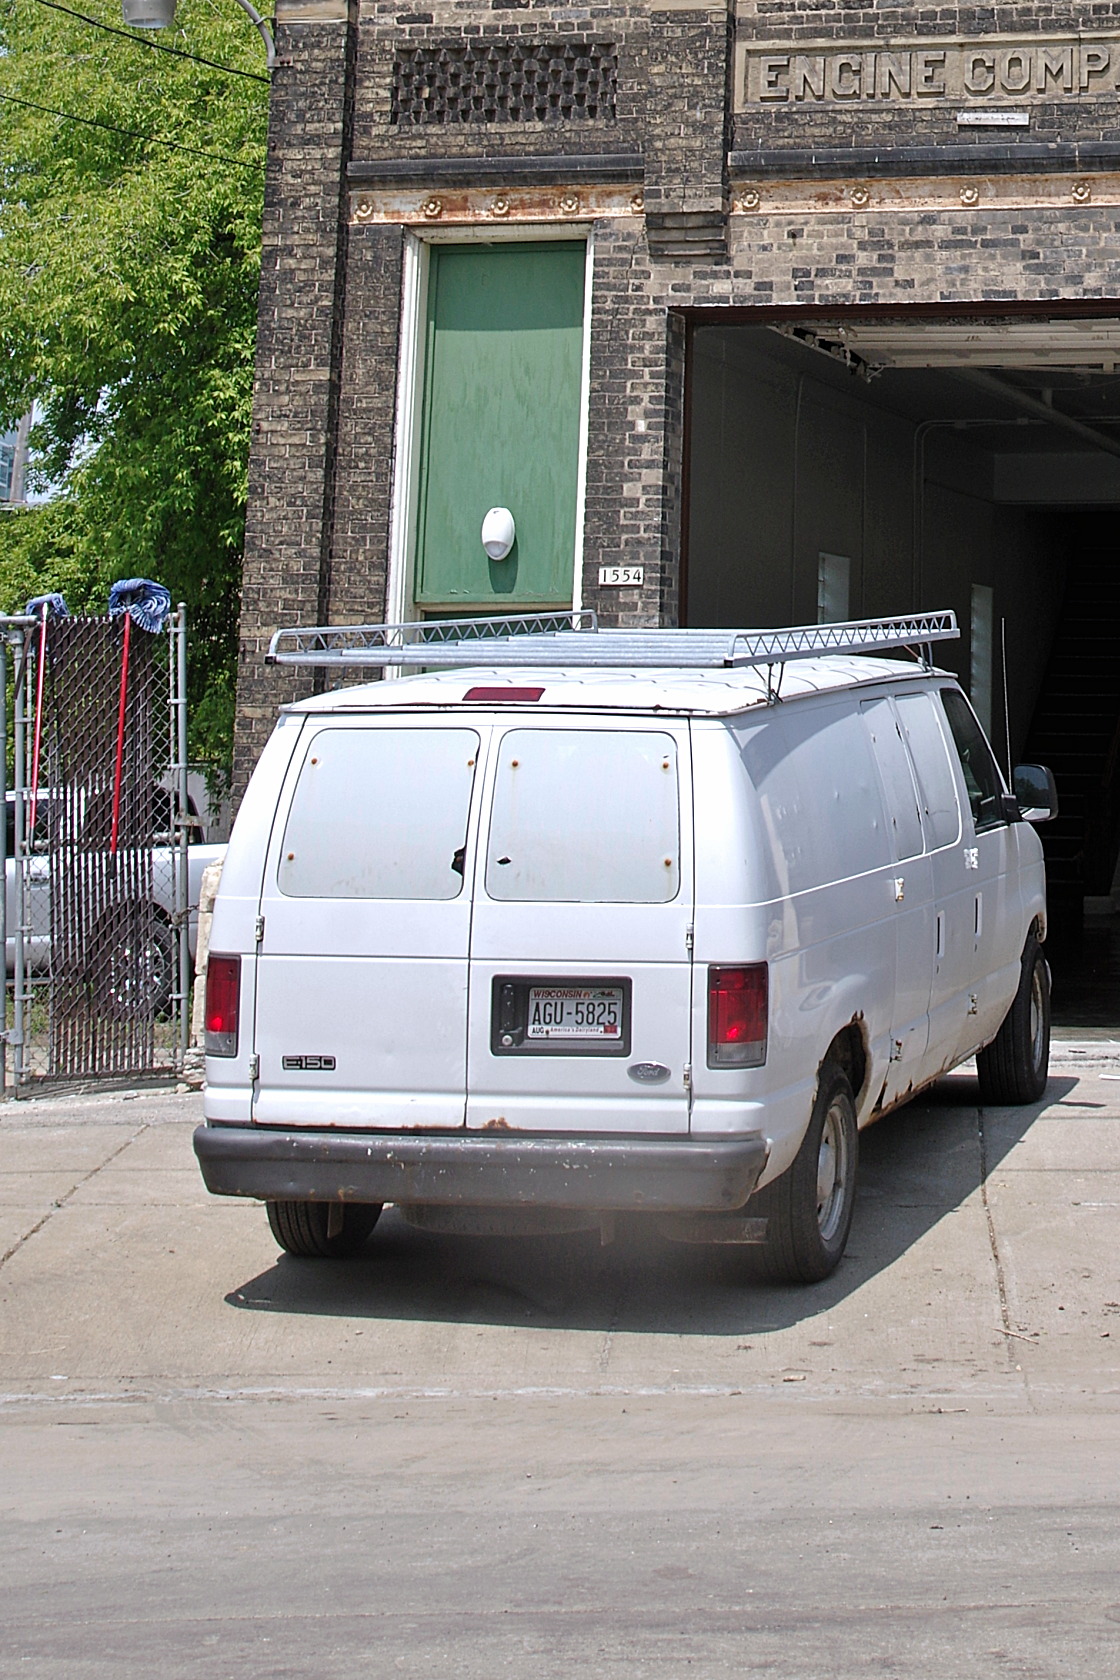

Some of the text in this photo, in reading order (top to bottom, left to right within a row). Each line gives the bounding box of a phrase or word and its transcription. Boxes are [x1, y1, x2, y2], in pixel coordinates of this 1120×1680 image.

[760, 51, 946, 101] ENGINE
[603, 569, 641, 583] 1554
[533, 989, 582, 998] WISCONSIN
[532, 1001, 618, 1025] AGU-5825
[532, 1026, 544, 1034] AUG
